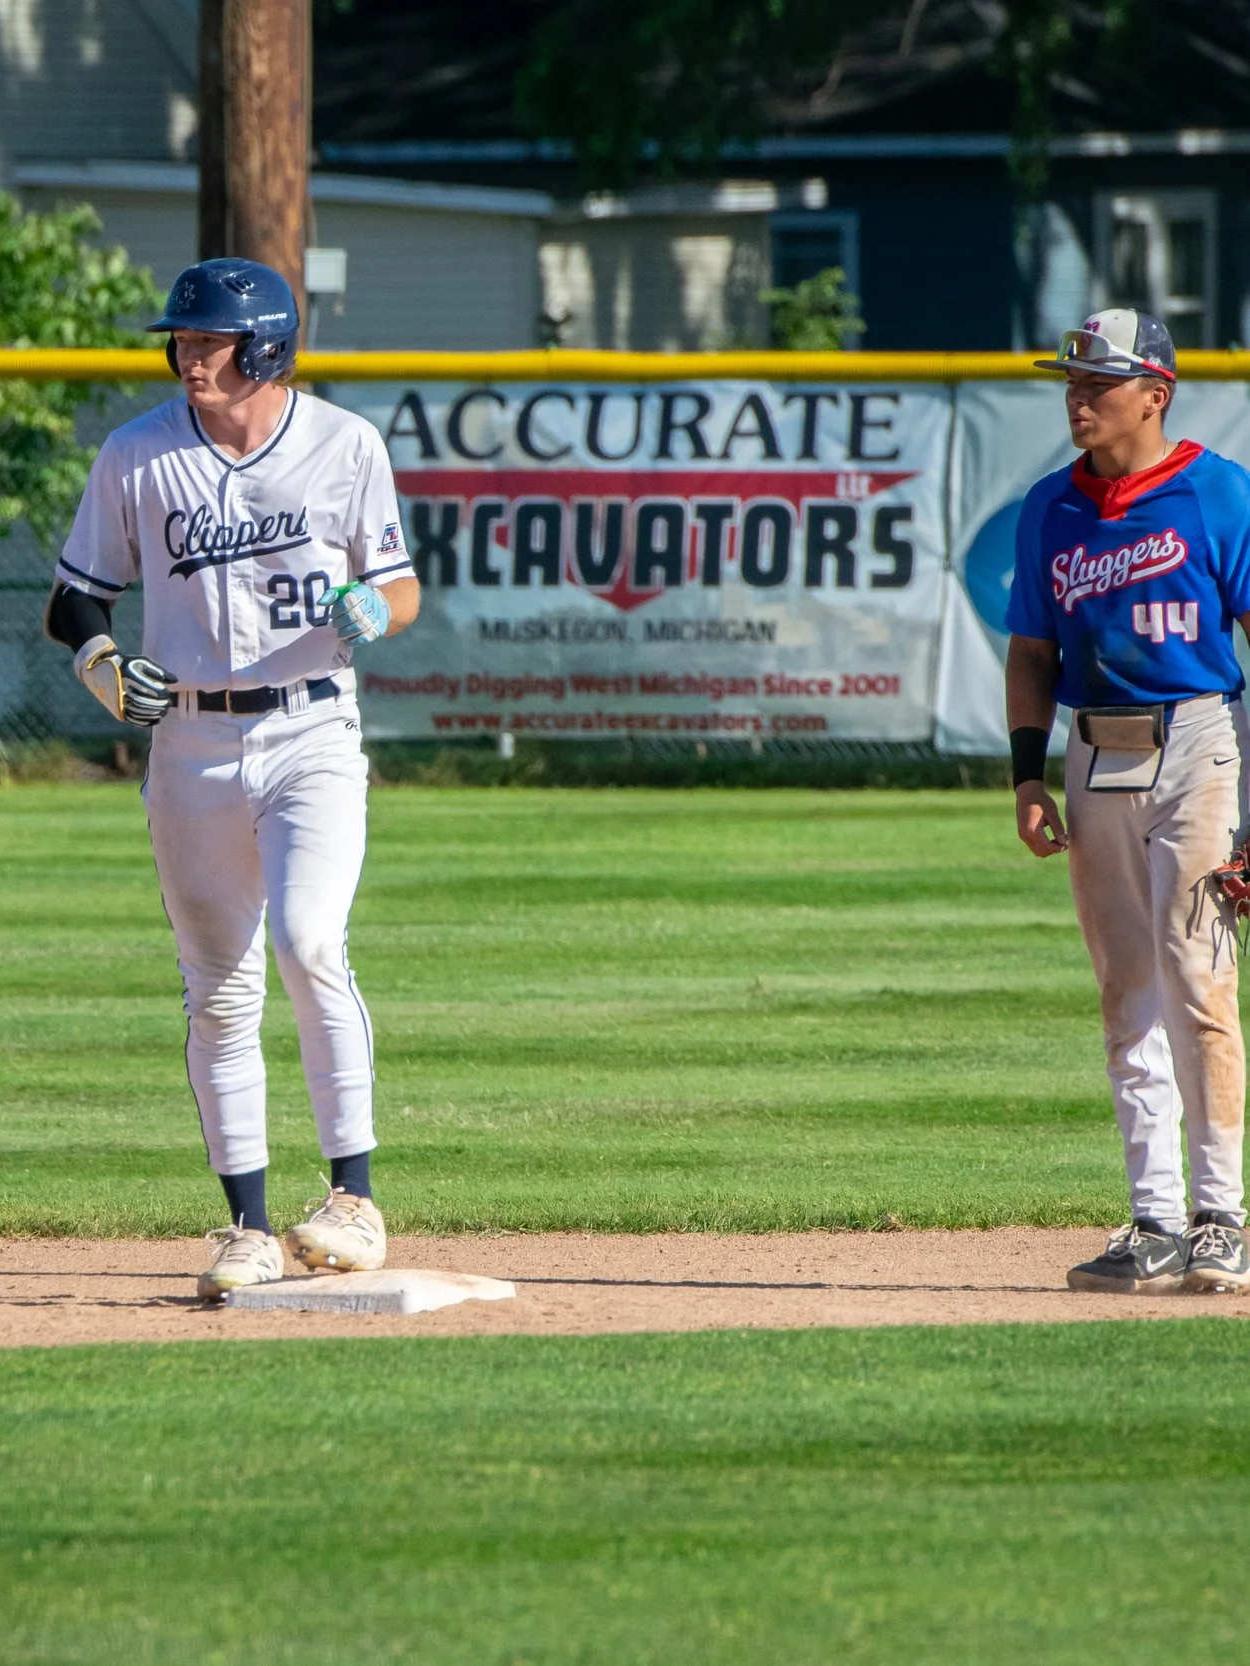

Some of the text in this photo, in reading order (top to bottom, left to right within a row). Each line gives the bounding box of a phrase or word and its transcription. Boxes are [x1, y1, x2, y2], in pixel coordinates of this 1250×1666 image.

[386, 388, 901, 462] ACCURATE
[165, 504, 310, 564] Clippers
[412, 501, 915, 588] XCAVATORS
[1052, 531, 1185, 601] Sluggers
[267, 570, 331, 630] 20
[1133, 601, 1199, 643] 44
[643, 618, 777, 643] MICHIGAN
[364, 670, 901, 702] Proudly Digging West Michigan Since 2001
